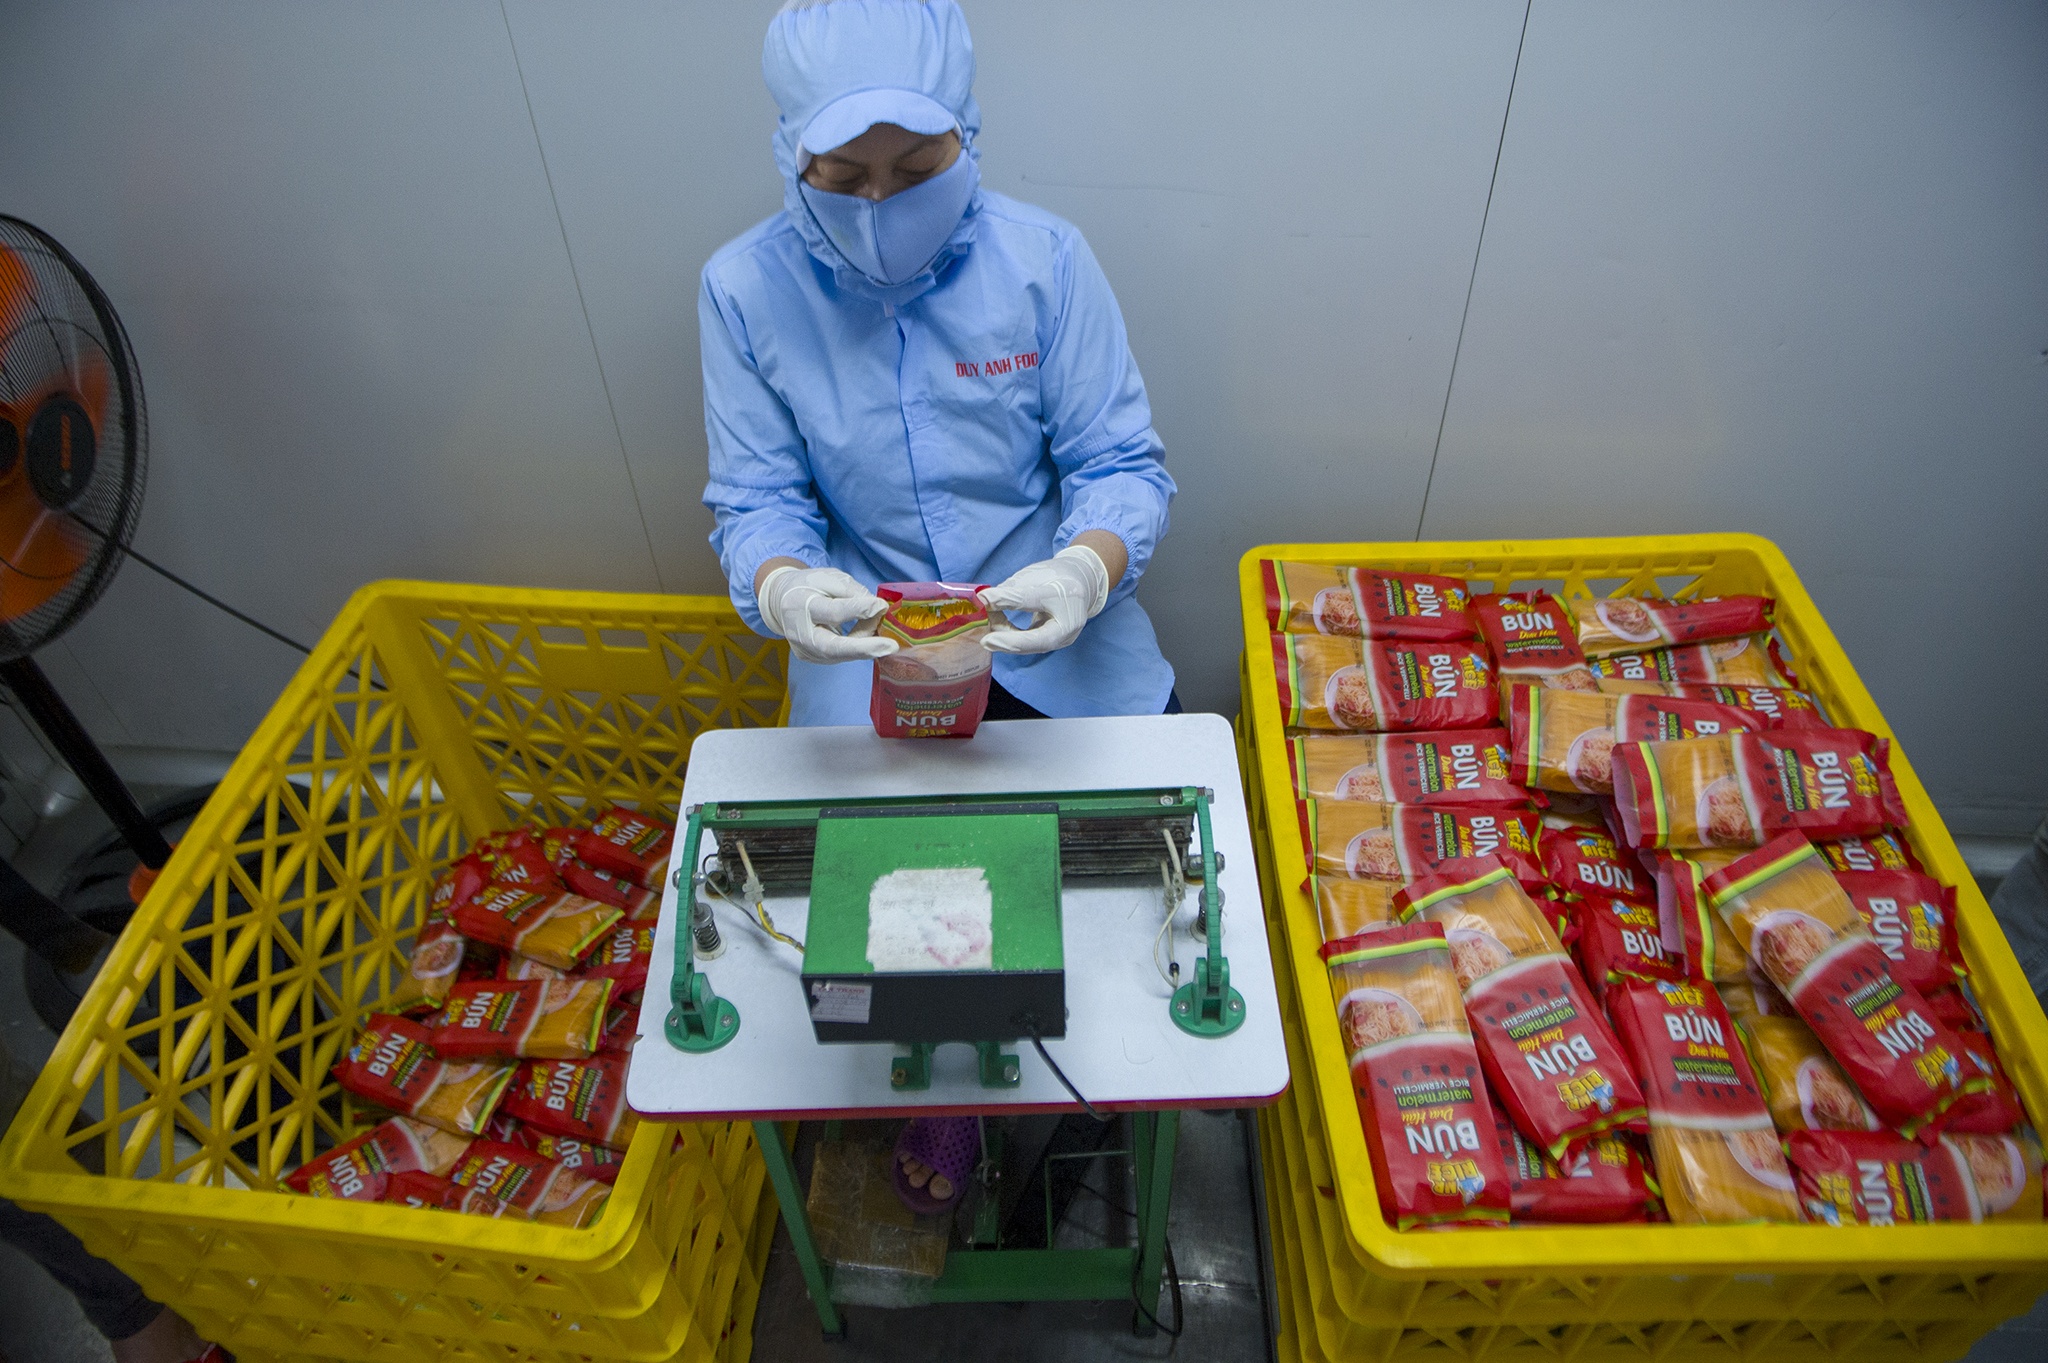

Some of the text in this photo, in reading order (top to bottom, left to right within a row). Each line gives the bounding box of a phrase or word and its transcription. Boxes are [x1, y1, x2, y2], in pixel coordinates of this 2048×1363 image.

[955, 362, 979, 378] DUY
[985, 358, 1012, 377] ANH
[1414, 583, 1443, 618] BÚN
[1505, 637, 1560, 649] watermelon
[1396, 652, 1411, 700] RICE VERMICELLI
[1404, 652, 1420, 699] watermelon
[1428, 654, 1460, 699] BÚN
[1460, 656, 1478, 689] RICE
[1614, 655, 1646, 680] BÚ
[896, 701, 962, 711] watermelon
[896, 714, 956, 727] BÚN
[1418, 757, 1428, 794] VERMICELLI
[1425, 743, 1440, 792] watermelon
[1451, 744, 1483, 790] BÚN
[1483, 747, 1503, 780] RICE
[1783, 749, 1805, 811] watermelon
[1811, 751, 1852, 808] BÚN
[1848, 755, 1873, 798] RICE
[610, 819, 645, 846] BÚN
[1433, 812, 1445, 860] RICE VERMICELLI
[1443, 814, 1457, 857] watermelon
[1470, 816, 1504, 858] BÚN
[1505, 820, 1522, 852] RICE
[1581, 845, 1617, 860] RICE
[1577, 860, 1635, 891] BÚN
[486, 888, 527, 912] BÚN
[1619, 913, 1658, 928] RICE
[1868, 897, 1909, 961] BÚN
[1908, 905, 1932, 952] RICE
[461, 992, 495, 1028] BÚN
[1501, 995, 1570, 1029] RICE VERMICELLI
[1664, 991, 1705, 1008] RICE
[1853, 983, 1902, 1018] watermelon
[1508, 1005, 1575, 1039] watermelon
[1663, 1007, 1725, 1047] BÚN
[1875, 1010, 1936, 1060] BÚN
[367, 1032, 408, 1078] BÚN
[1525, 1033, 1597, 1082] BÚN
[1673, 1060, 1735, 1076] watermelon
[546, 1061, 576, 1111] BÚN
[574, 1069, 598, 1119] watermelon
[1393, 1078, 1470, 1095] RICE VERMICELLI
[1557, 1070, 1605, 1099] RICE
[1676, 1071, 1741, 1086] RICE VERMICELLI
[1398, 1088, 1472, 1107] watermelon
[556, 1140, 582, 1168] BÚ
[1405, 1120, 1480, 1160] BÚN
[328, 1154, 364, 1198] BÚN
[1430, 1160, 1478, 1180] RICE
